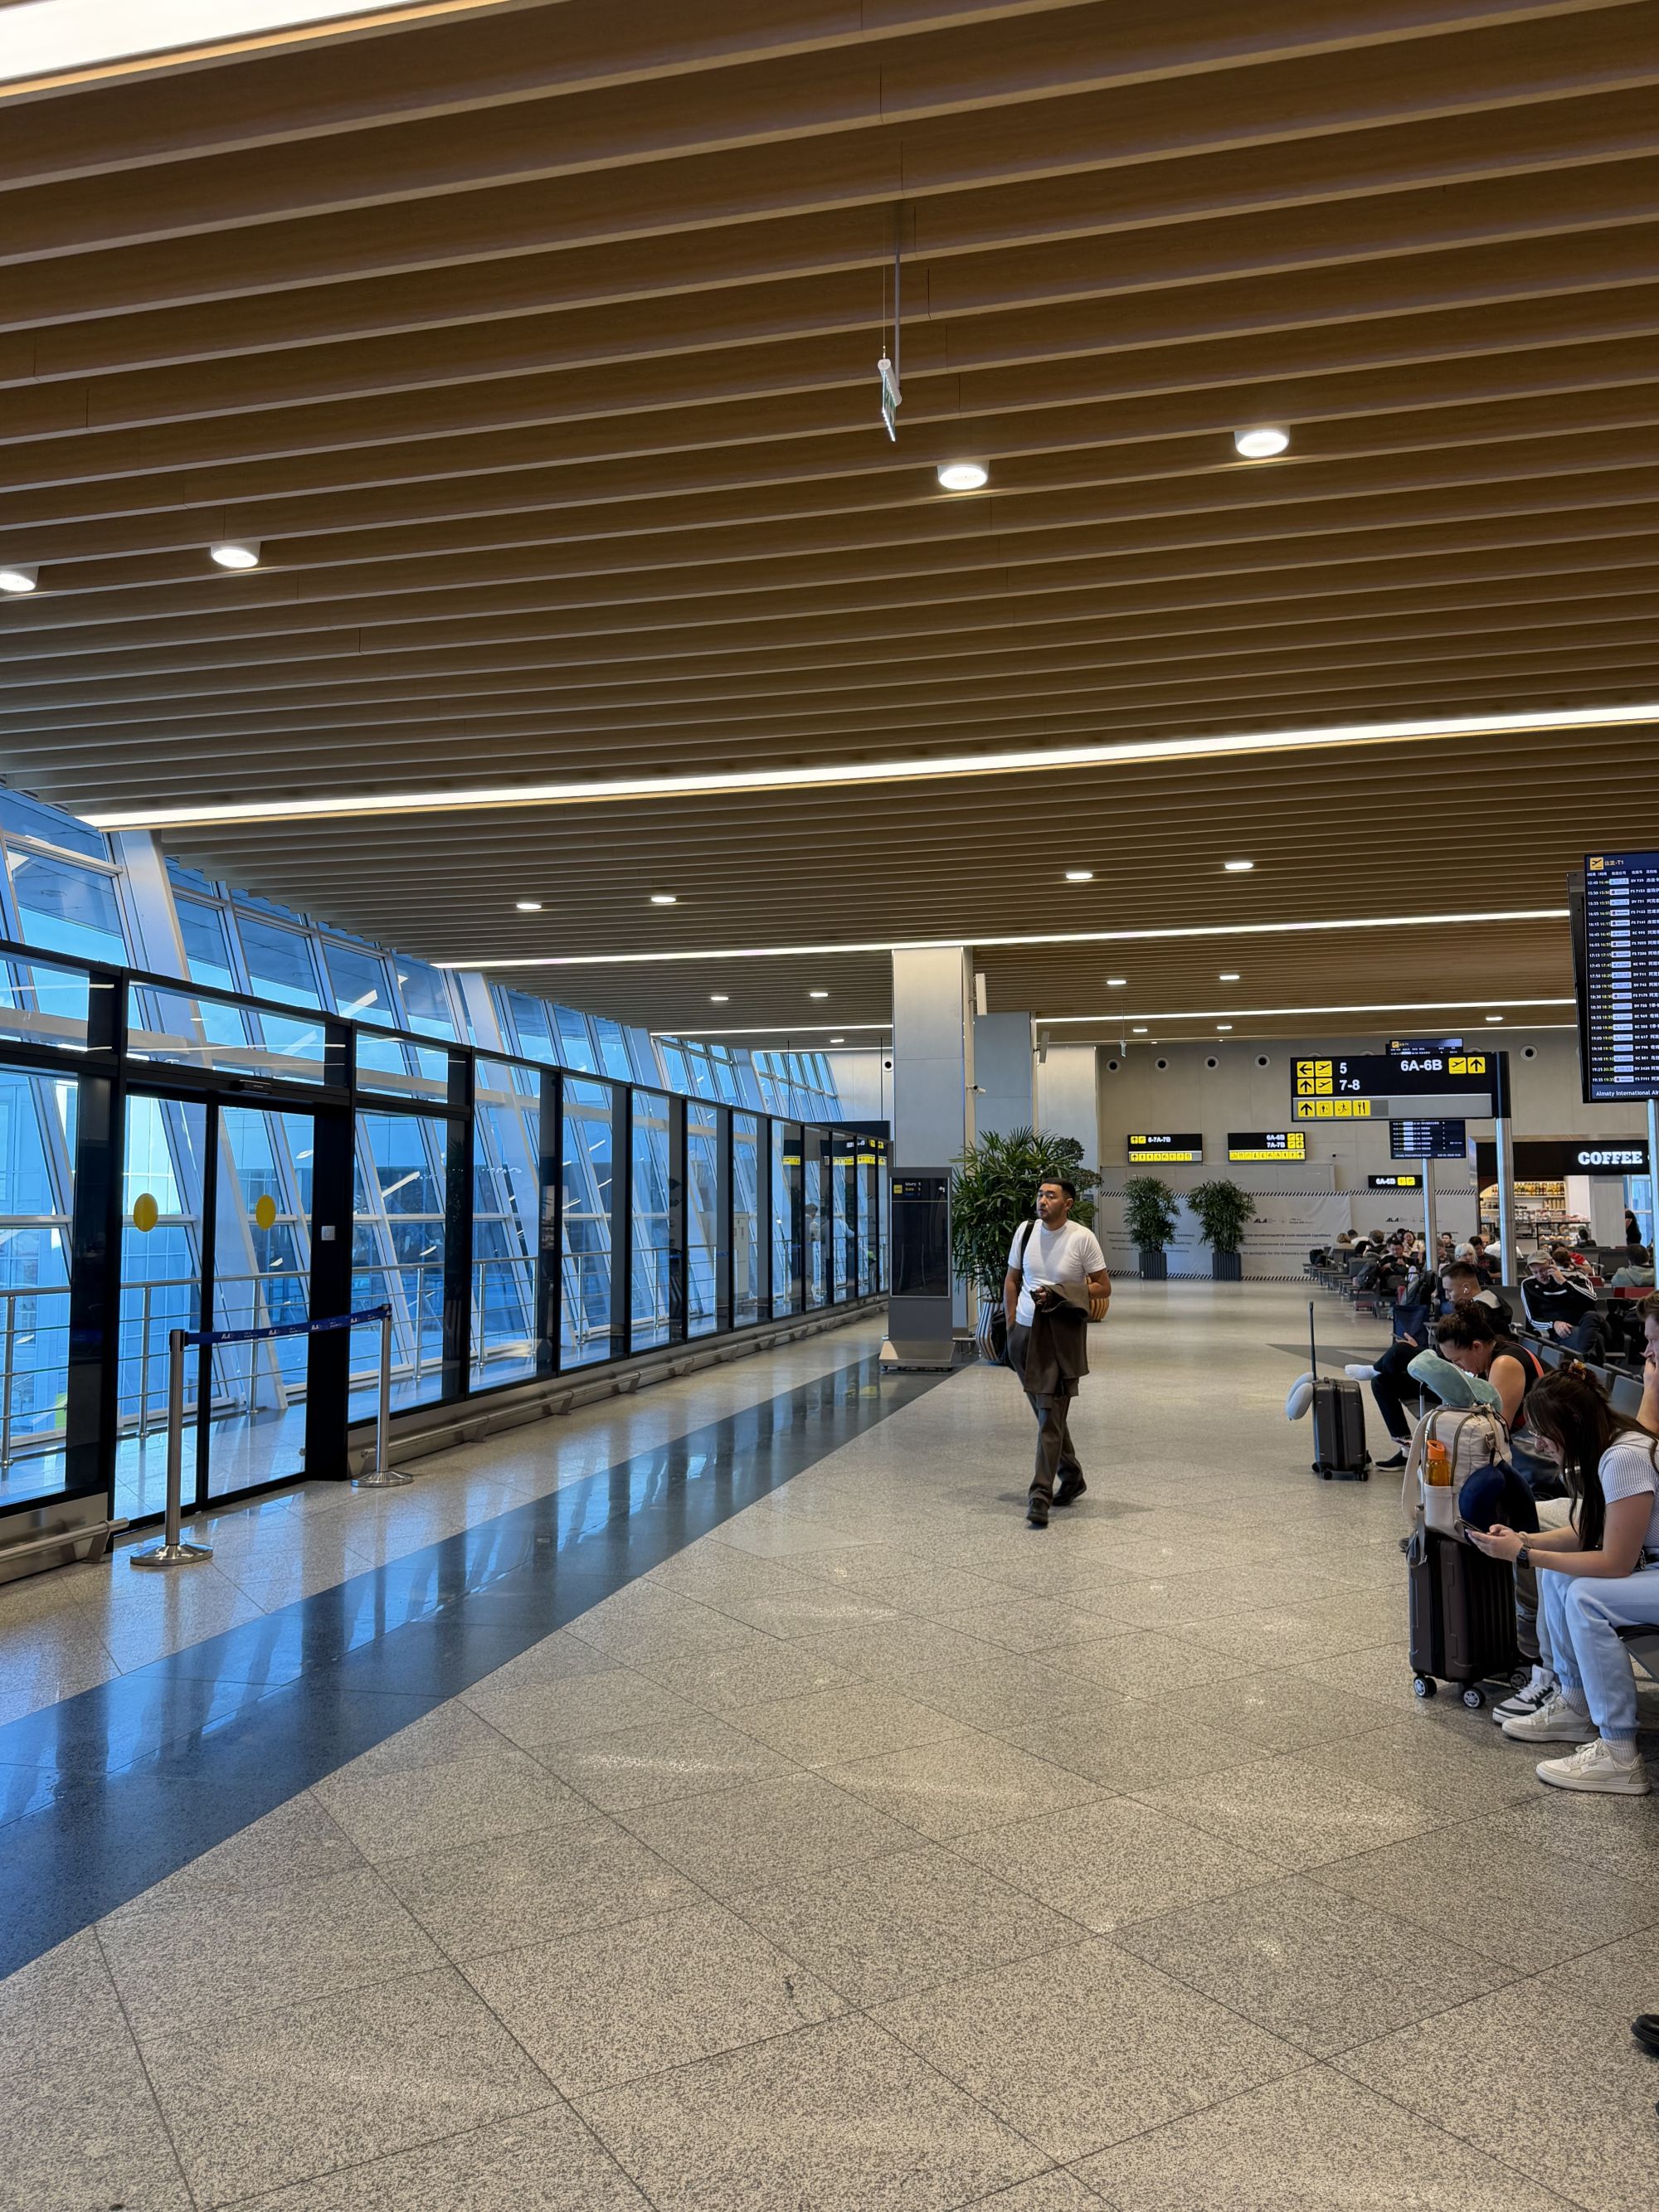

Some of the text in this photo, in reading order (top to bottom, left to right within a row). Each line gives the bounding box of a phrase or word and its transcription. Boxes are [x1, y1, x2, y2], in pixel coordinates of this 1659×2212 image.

[1340, 1062, 1347, 1074] 5
[1401, 1060, 1443, 1071] 6A-6B
[1339, 1079, 1360, 1091] 7-8
[1578, 1151, 1643, 1165] COFFEE
